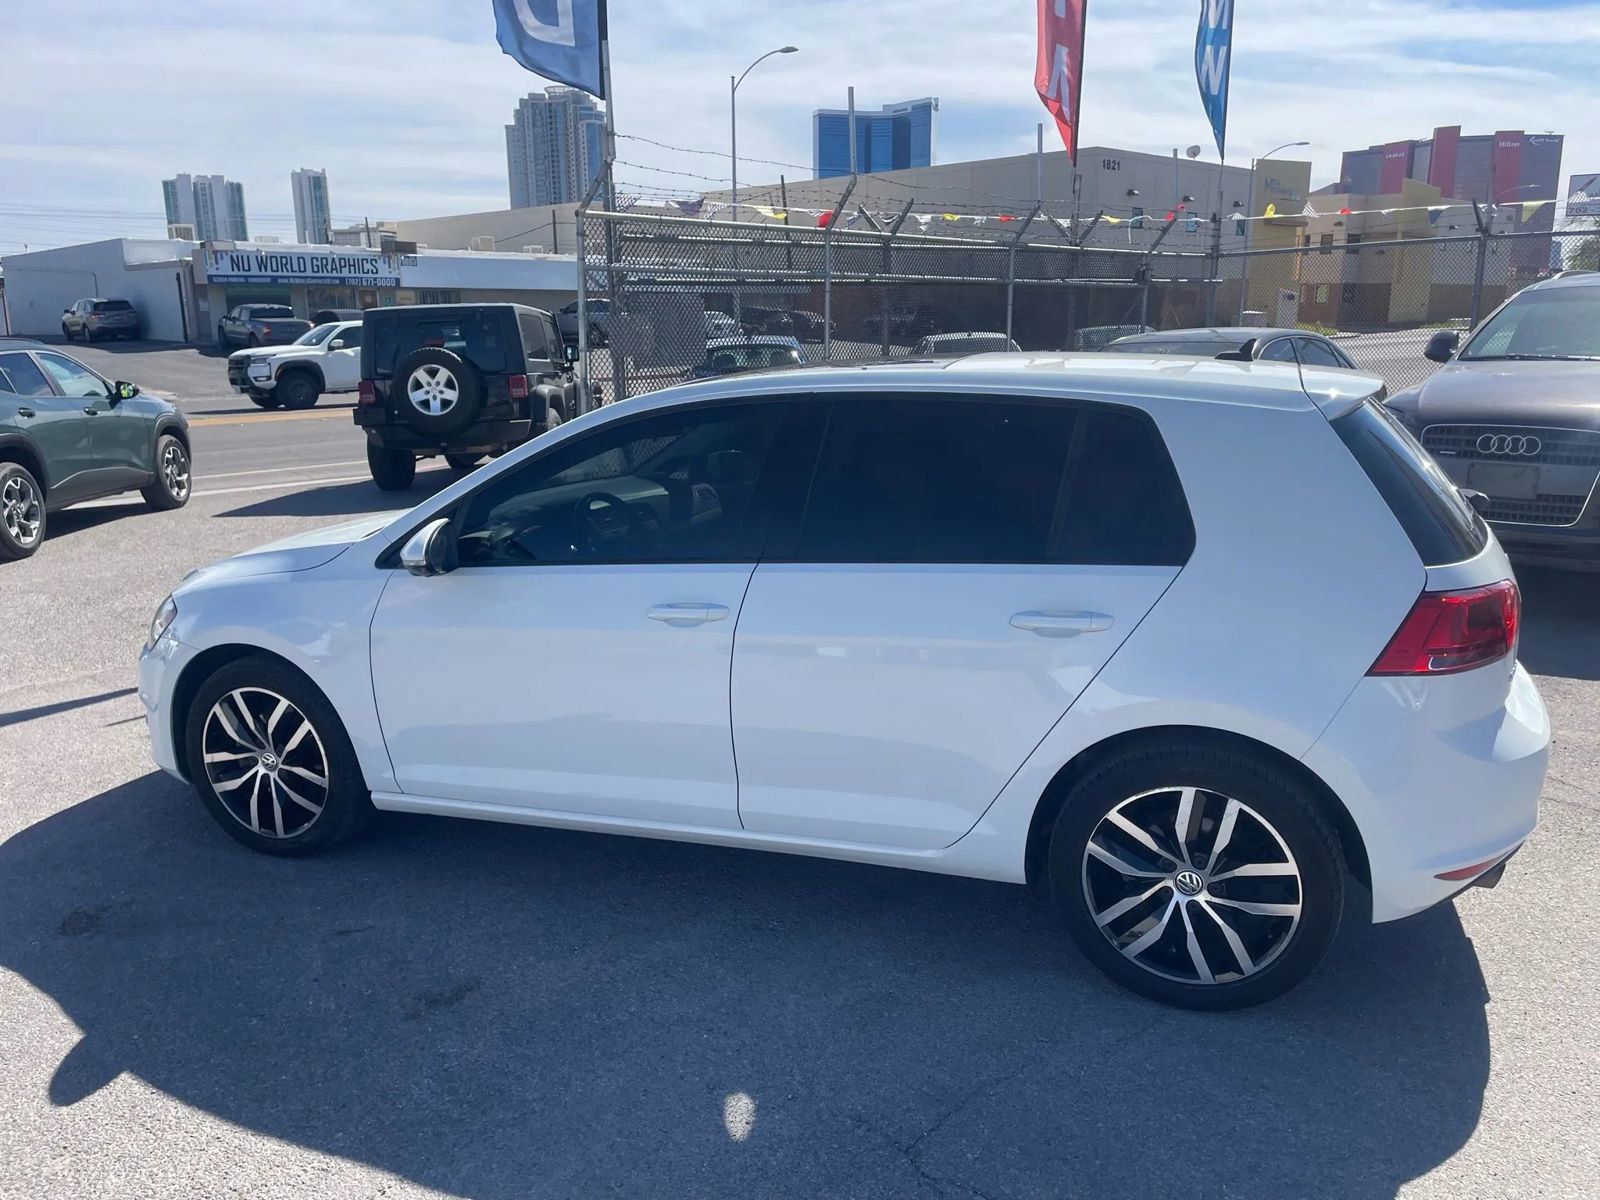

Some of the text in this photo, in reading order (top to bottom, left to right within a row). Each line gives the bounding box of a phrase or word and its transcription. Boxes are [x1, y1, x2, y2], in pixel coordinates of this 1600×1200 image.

[1102, 158, 1121, 171] 1821
[230, 254, 251, 273] NU
[255, 255, 307, 274] WORLD
[311, 256, 379, 275] GRAPHICS
[345, 277, 361, 287] (702)
